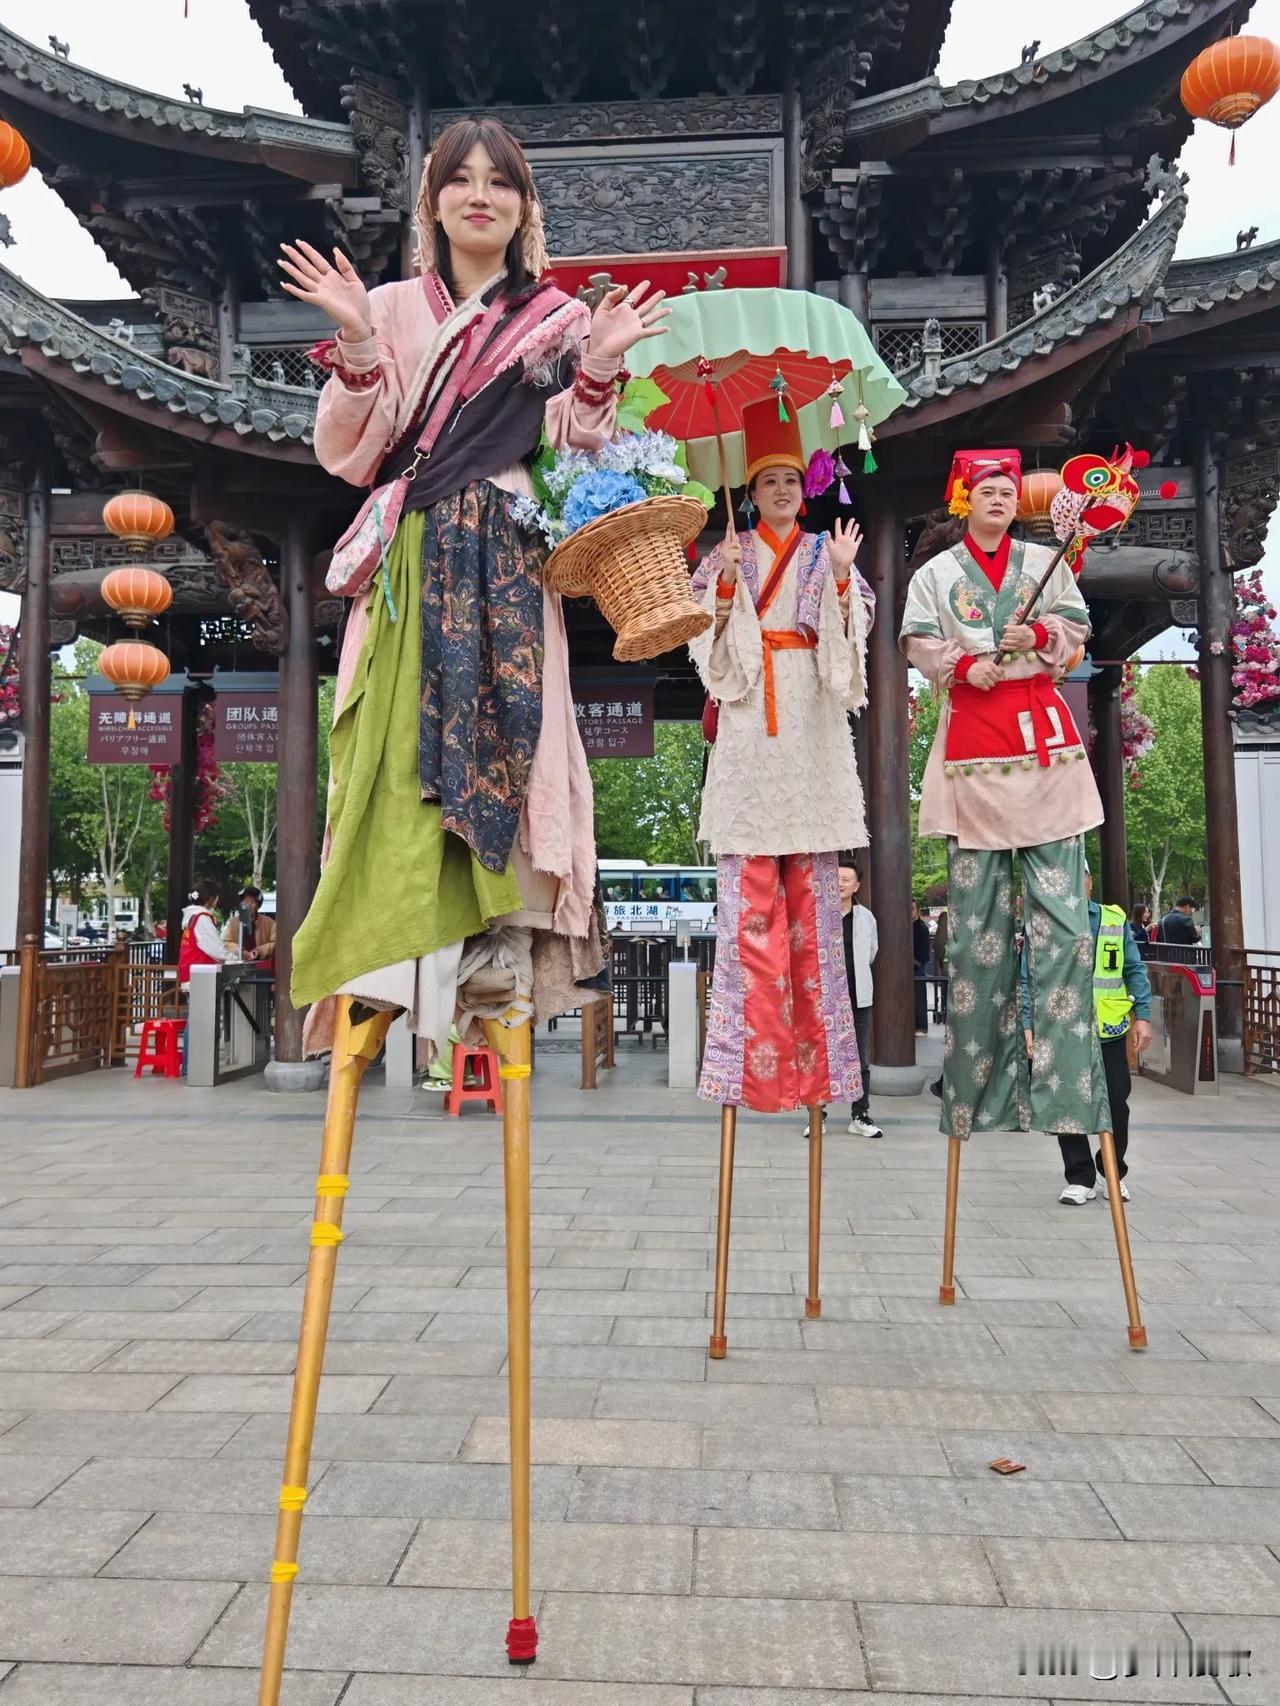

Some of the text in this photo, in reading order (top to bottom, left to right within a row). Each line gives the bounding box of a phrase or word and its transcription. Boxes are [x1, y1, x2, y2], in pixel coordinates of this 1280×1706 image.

[226, 707, 278, 722] 团队通
[606, 717, 645, 725] PASSAGE
[225, 723, 258, 731] GROUPS
